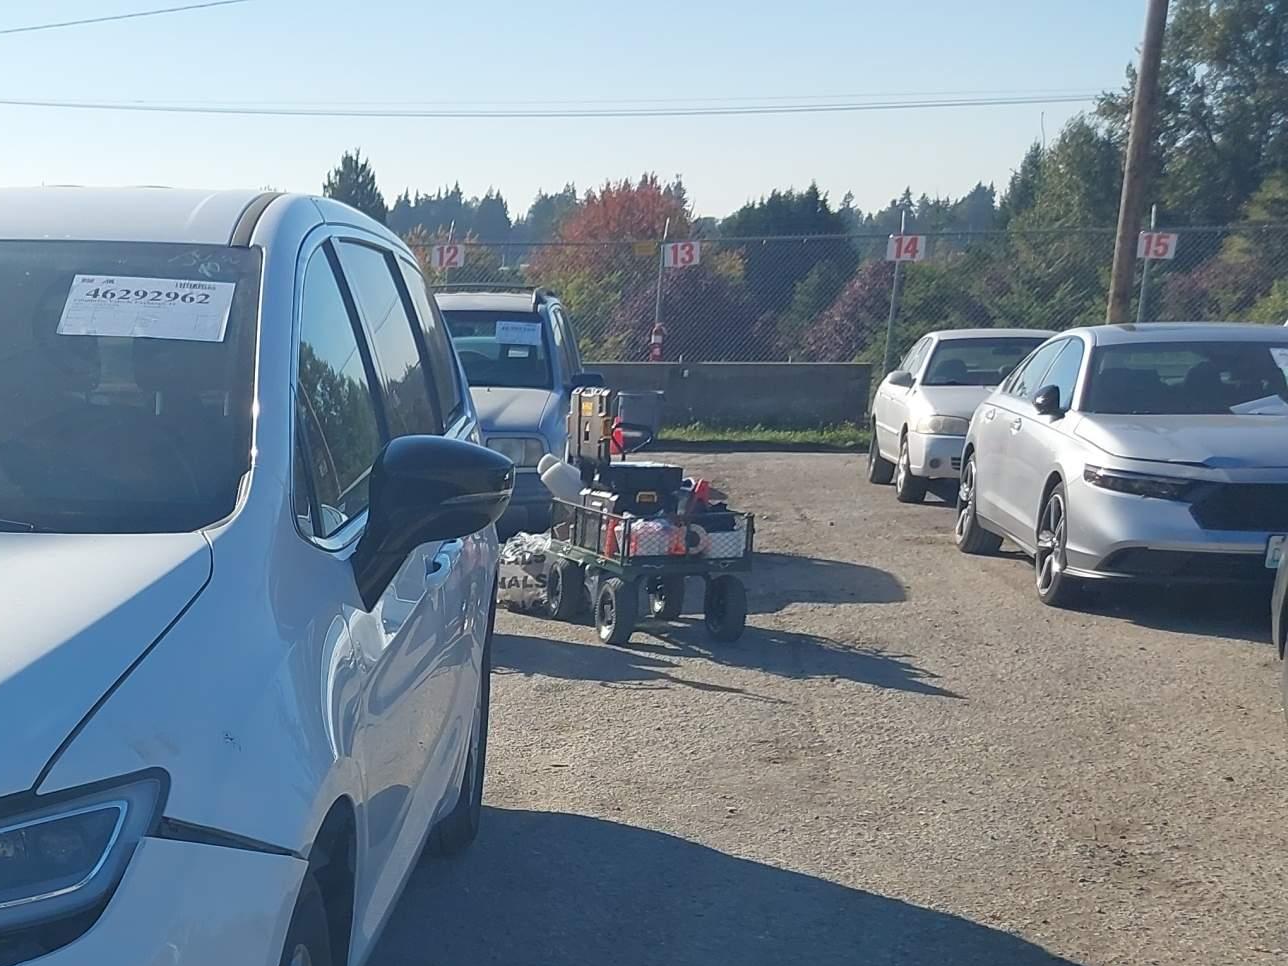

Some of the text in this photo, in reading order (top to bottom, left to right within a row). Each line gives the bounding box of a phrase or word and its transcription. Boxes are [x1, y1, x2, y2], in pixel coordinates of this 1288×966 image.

[671, 242, 694, 265] 13
[895, 237, 919, 259] 14
[1143, 233, 1170, 257] 15
[436, 246, 458, 267] 12
[85, 287, 210, 305] 46292962
